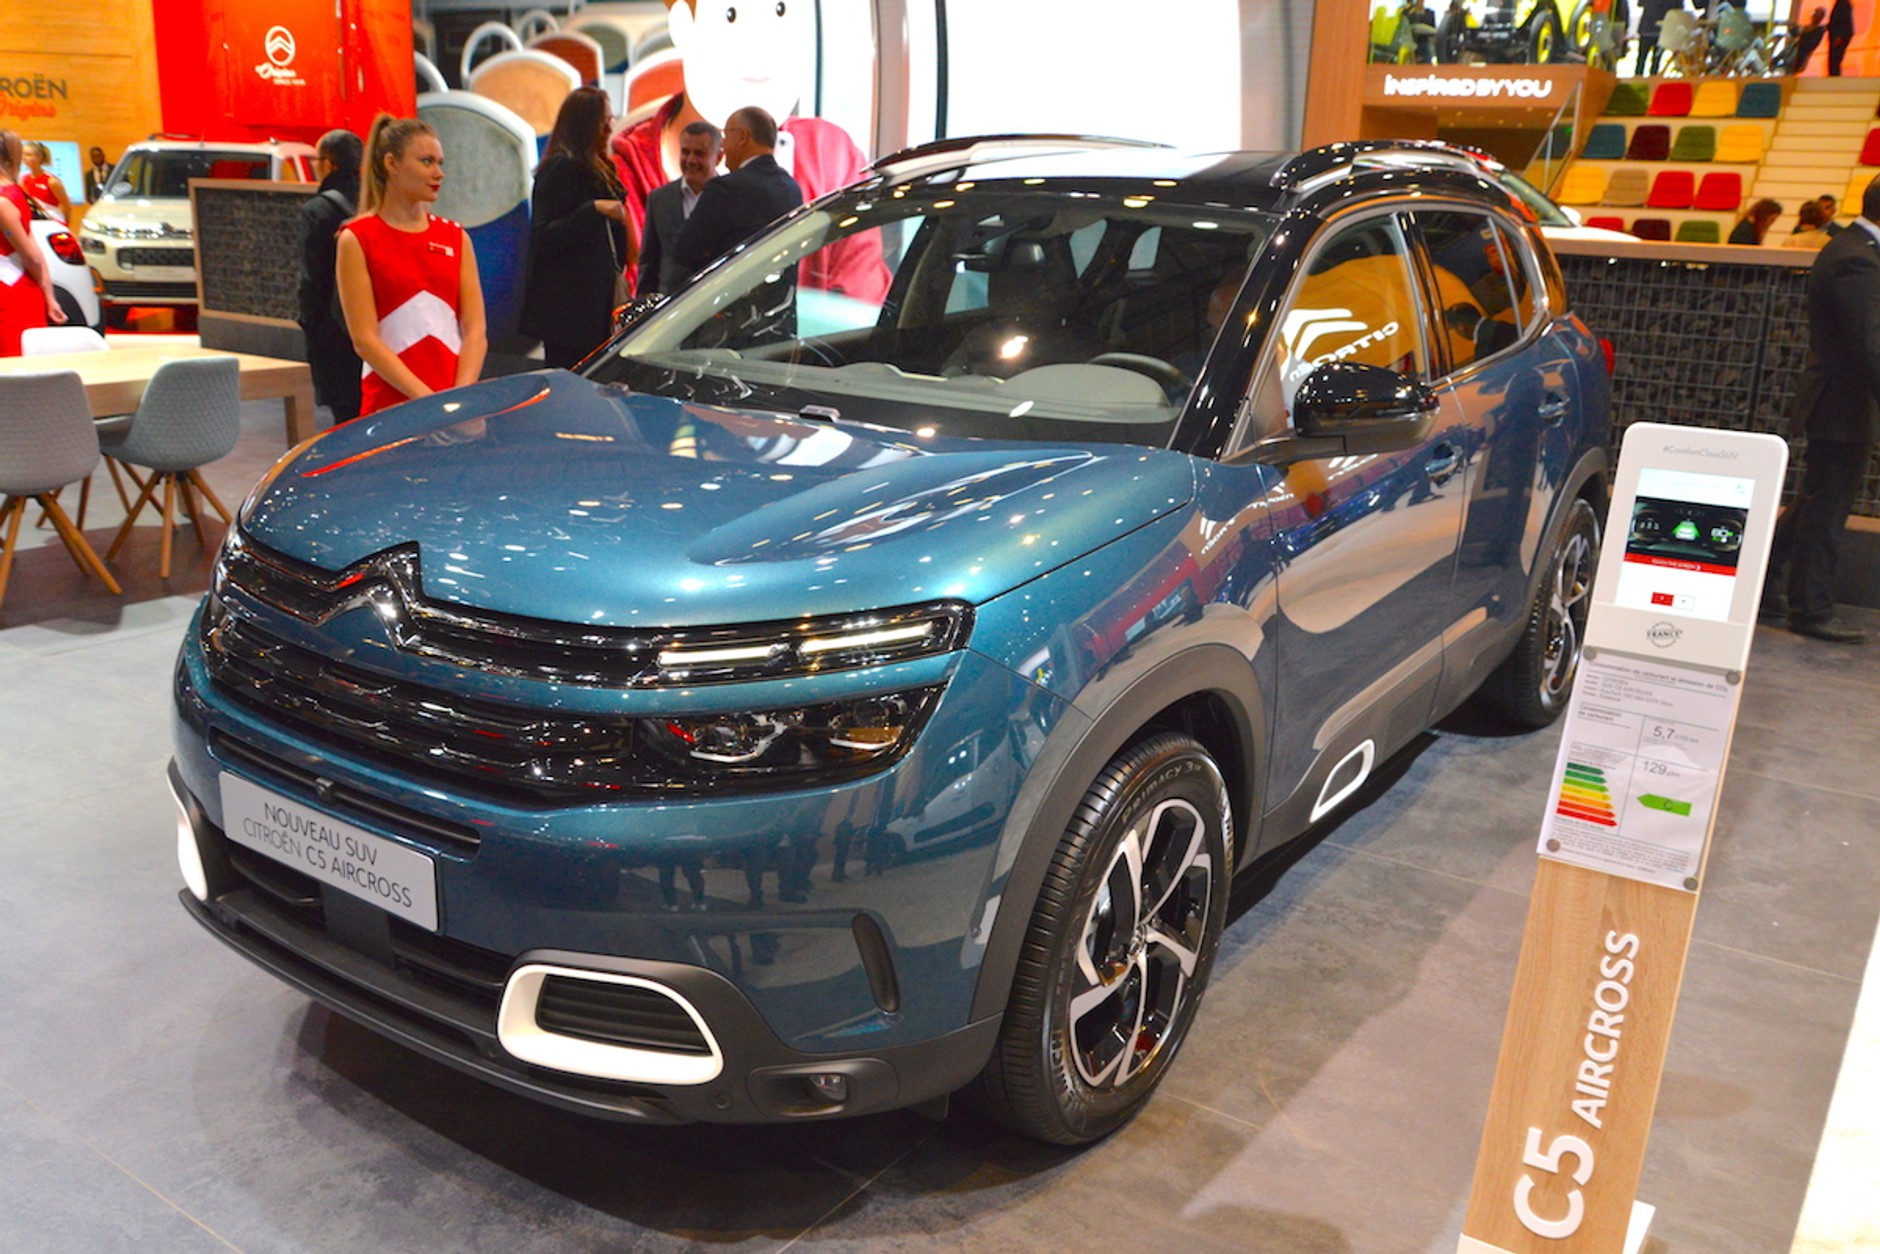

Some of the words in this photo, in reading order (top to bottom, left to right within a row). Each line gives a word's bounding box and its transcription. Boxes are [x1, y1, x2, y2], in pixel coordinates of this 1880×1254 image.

[1504, 78, 1553, 98] YOU
[1653, 725, 1675, 740] 5,7
[1643, 760, 1667, 776] 129
[1663, 799, 1673, 811] C
[264, 802, 341, 851] NOUVEAU
[345, 837, 377, 865] SUV
[243, 817, 302, 858] CITROËN
[306, 846, 327, 870] C5
[331, 857, 413, 908] AIRCROSS
[1513, 1126, 1595, 1239] C5
[1571, 930, 1640, 1130] AIRCROSS
